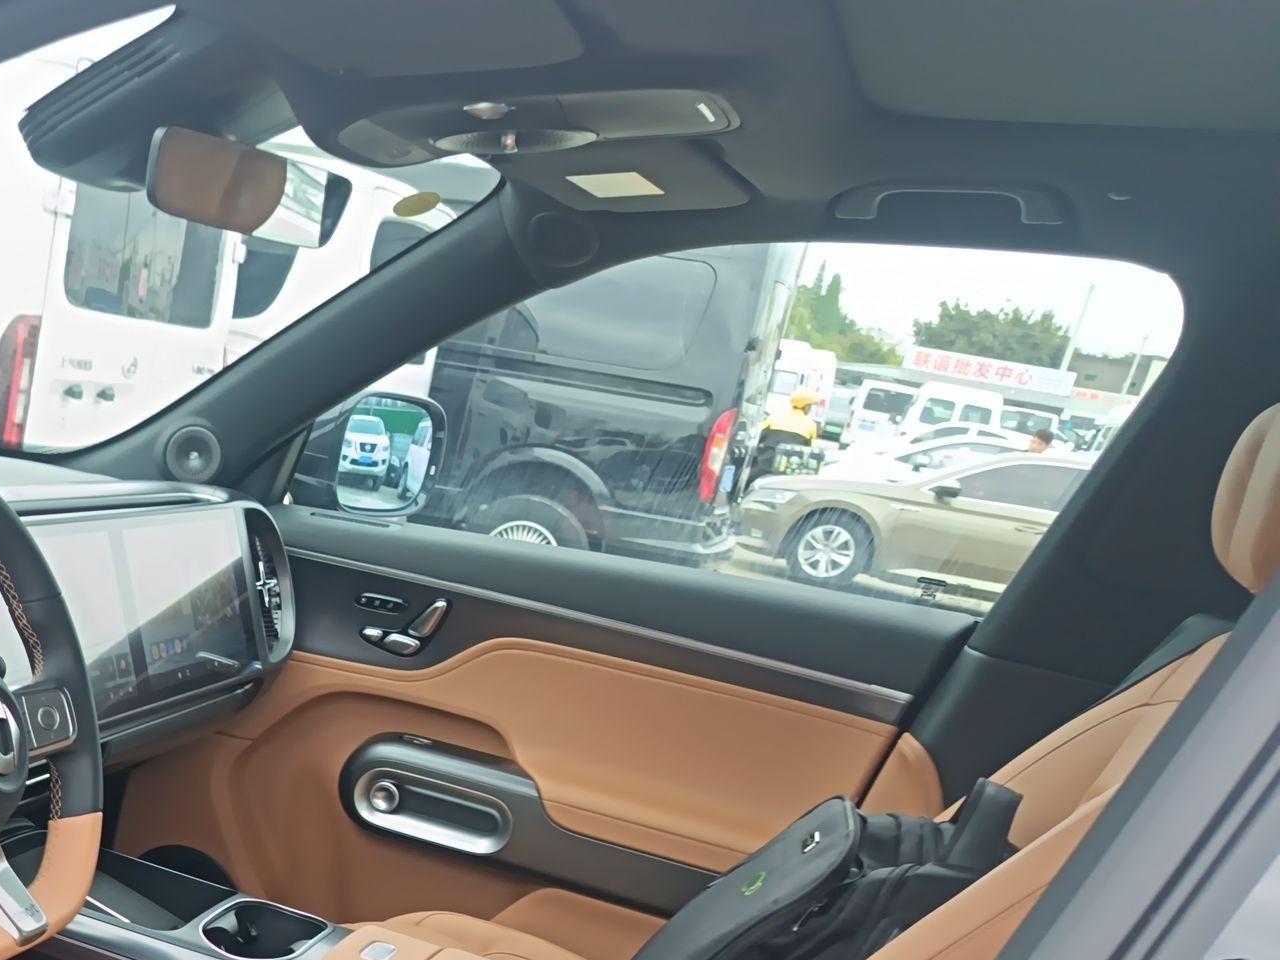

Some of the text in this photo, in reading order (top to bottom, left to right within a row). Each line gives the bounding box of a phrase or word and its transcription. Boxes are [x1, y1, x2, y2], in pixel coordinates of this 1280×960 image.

[912, 351, 1032, 385] 联谊批发中心
